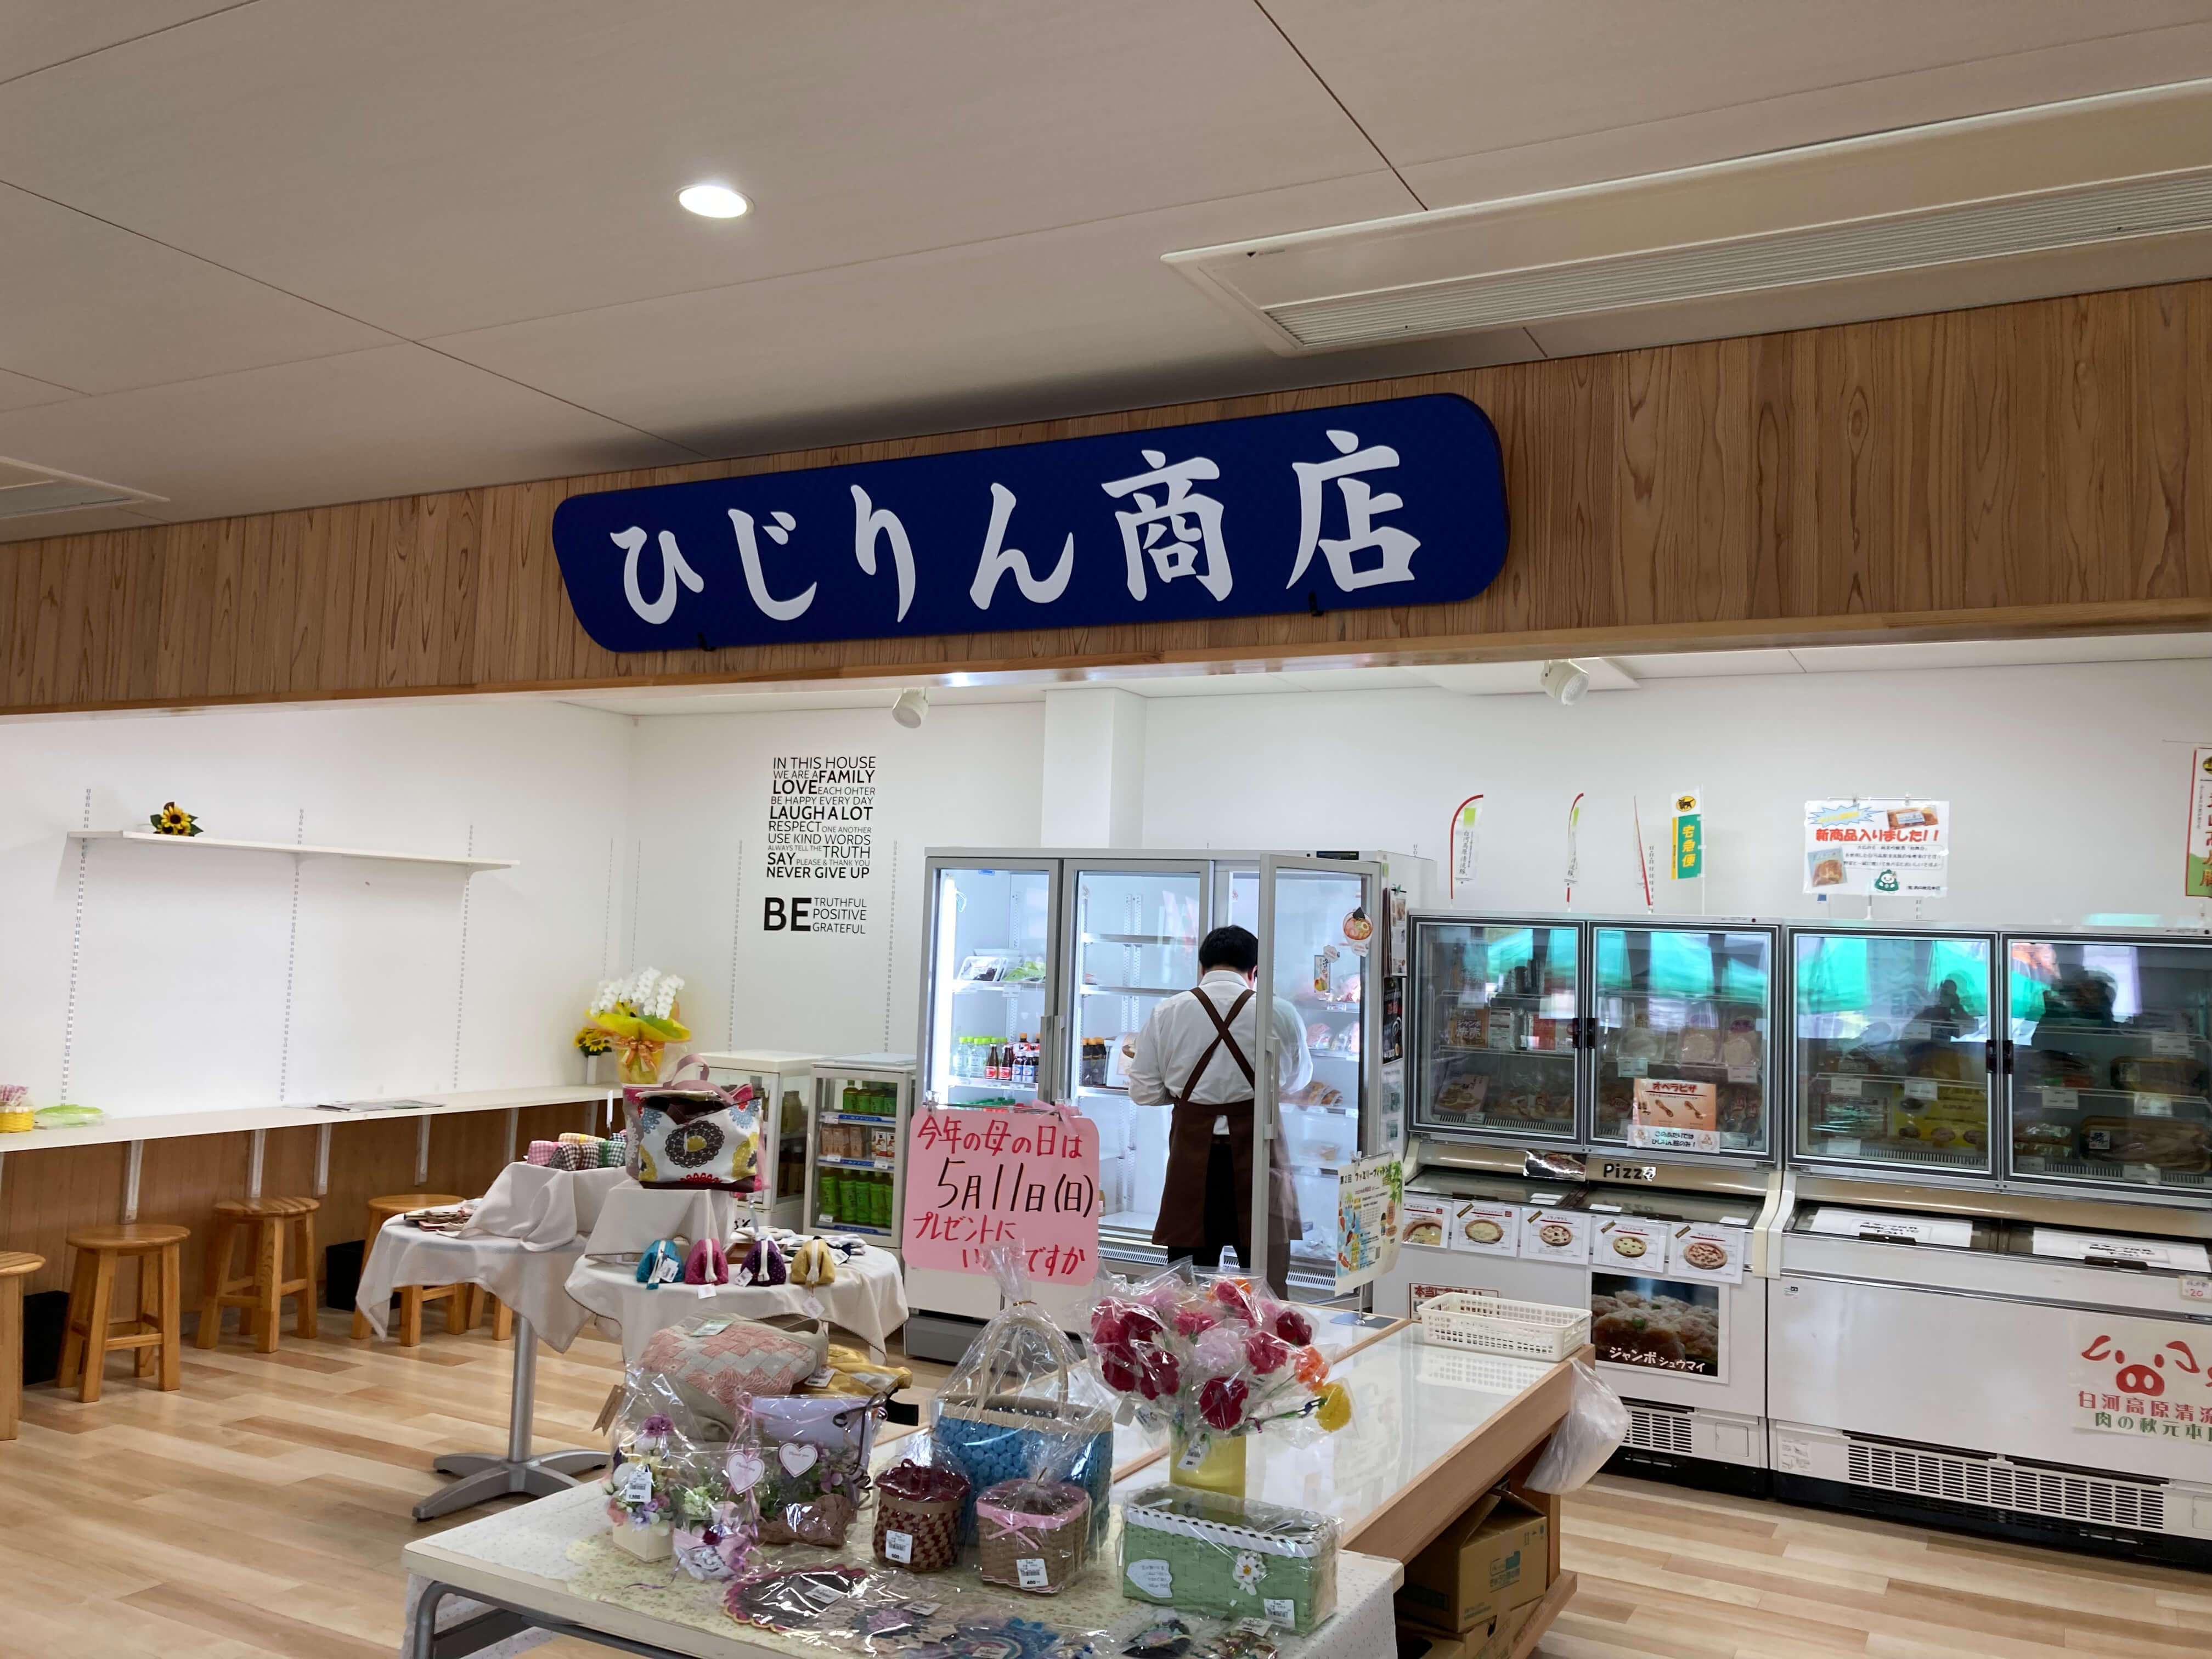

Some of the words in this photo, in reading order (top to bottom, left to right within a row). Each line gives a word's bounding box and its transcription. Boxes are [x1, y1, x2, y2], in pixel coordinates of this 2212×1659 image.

[611, 428, 1421, 624] ひじりん商店
[774, 757, 786, 769] IN
[791, 757, 821, 769] THIS
[826, 757, 876, 769] HOUSE
[774, 771, 789, 779] WE
[819, 770, 875, 783] FAMILY
[774, 780, 817, 794] LOVE
[818, 787, 842, 795] EACH
[844, 787, 876, 795] OHTER
[771, 796, 782, 804] BE
[785, 797, 817, 805] HAPPY
[820, 797, 850, 805] EVERY
[853, 797, 874, 805] DAY
[770, 806, 825, 820] LAUGH
[827, 806, 838, 820] A
[842, 806, 873, 820] LOT
[769, 821, 822, 832] RESPECT
[768, 833, 790, 844] USE
[793, 833, 821, 844] KIND
[825, 834, 871, 845] WORDS
[822, 845, 870, 859] TRUTH
[1682, 825, 1696, 868] 宅急便
[768, 852, 795, 865] SAY
[766, 867, 811, 878] NEVER
[814, 867, 847, 878] GIVE
[850, 867, 870, 878] UP
[814, 898, 867, 908] TRUTHFUL
[764, 897, 812, 932] BE
[813, 909, 867, 921] POSITIVE
[812, 922, 866, 934] GRATEFUL
[917, 1114, 1083, 1159] 今年の母の日は
[937, 1156, 1093, 1218] 5月11日(日)
[913, 1211, 1016, 1244] プレゼントに
[963, 1244, 1086, 1277] いですか
[2078, 1391, 2212, 1425] 白河高原清流
[2095, 1412, 2212, 1442] 肉の秋元本
